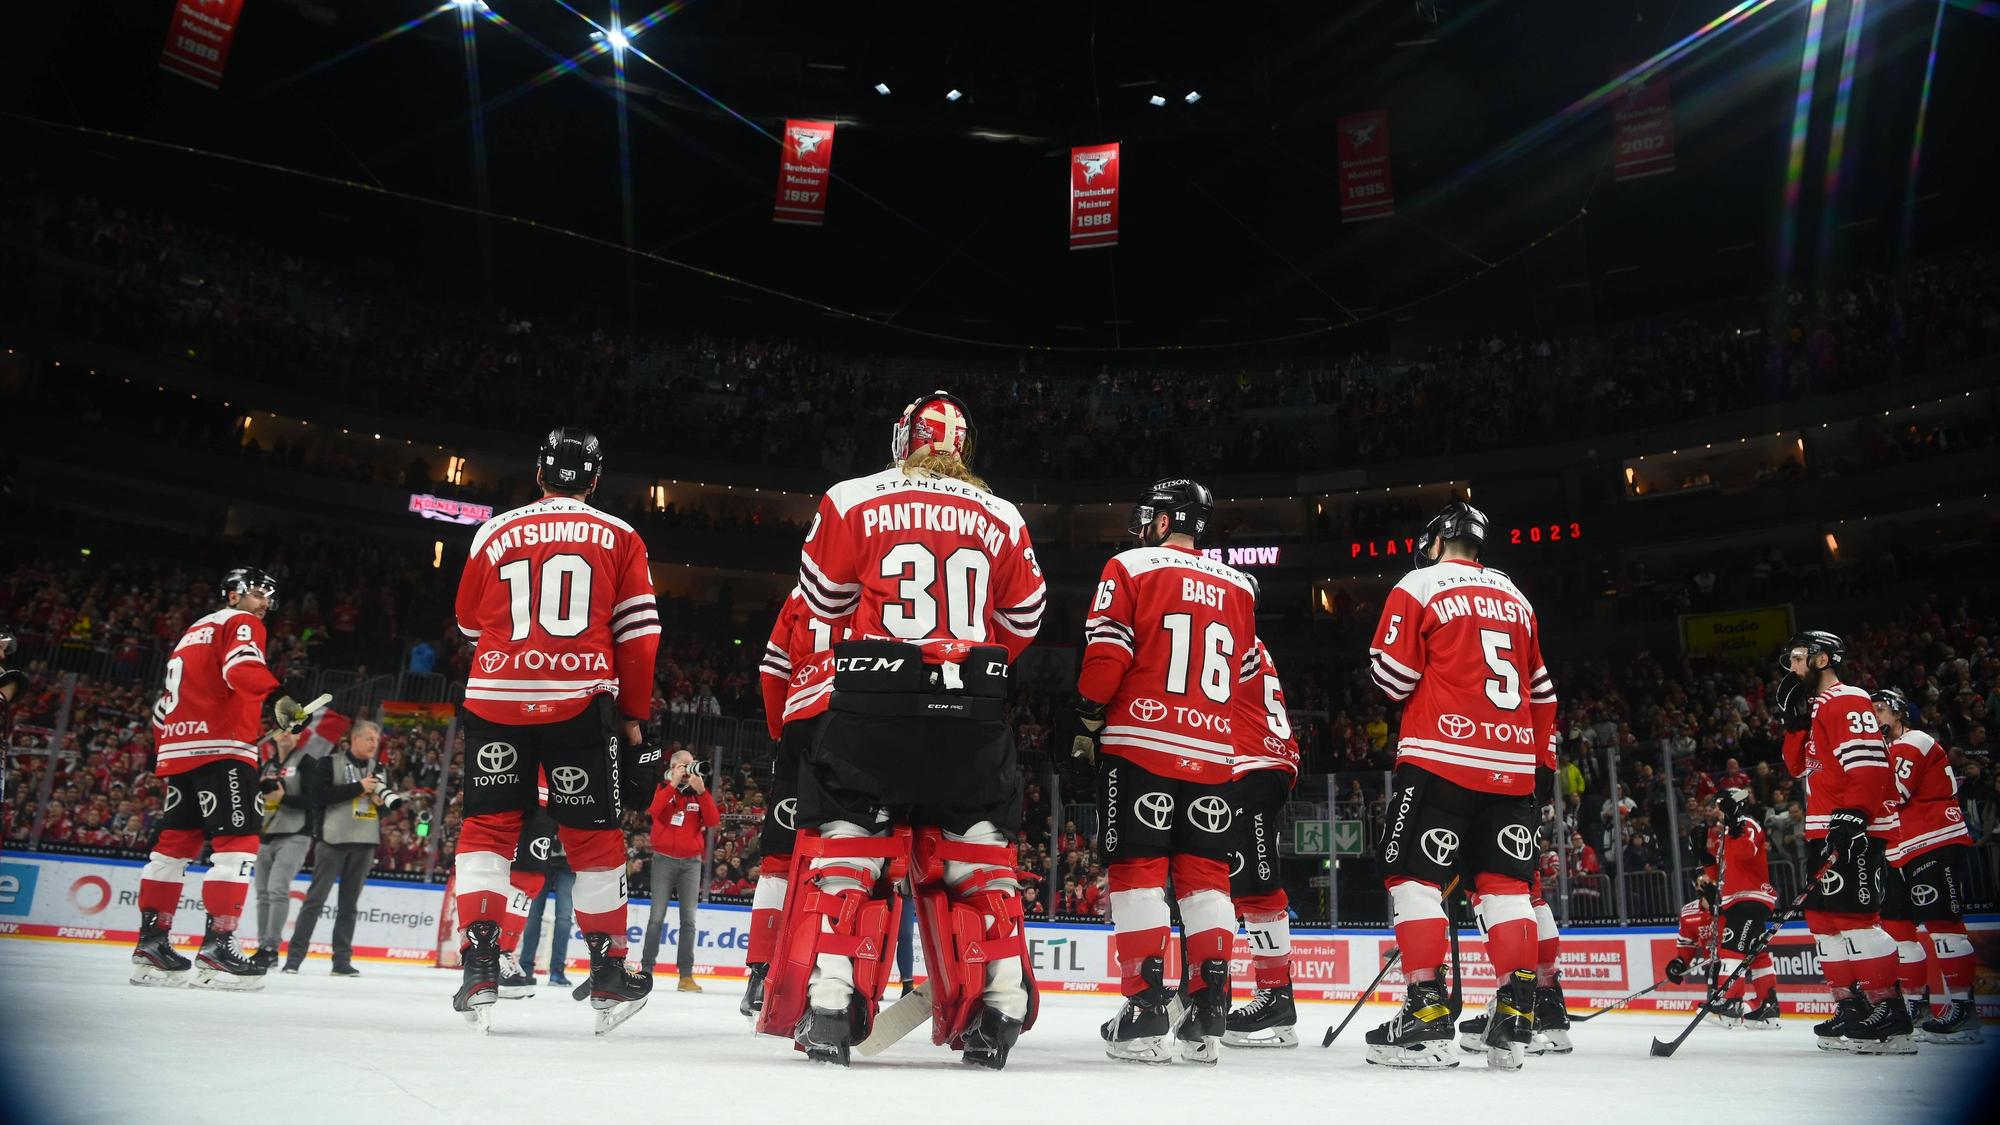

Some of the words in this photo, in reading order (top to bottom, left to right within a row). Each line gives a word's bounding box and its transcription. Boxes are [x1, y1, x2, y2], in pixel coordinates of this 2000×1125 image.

[784, 162, 827, 174] Deutscher
[1342, 155, 1386, 168] Deutscher
[786, 175, 820, 186] Meister
[1347, 169, 1382, 181] Meister
[784, 189, 819, 203] 1987
[1074, 187, 1115, 198] Deutscher
[1078, 201, 1111, 209] Meister
[1077, 213, 1111, 227] 1988
[546, 455, 554, 465] 10
[584, 462, 592, 471] 10
[874, 478, 993, 510] STAHLWERK
[1153, 479, 1190, 491] STETSON
[1175, 512, 1186, 521] 16
[862, 502, 1005, 558] PANTKOWSKI
[1510, 522, 1583, 544] 2023
[485, 521, 615, 567] MATSUMOTO
[1350, 538, 1414, 558] PLAY
[1227, 546, 1279, 565] NOW
[500, 553, 593, 642] 10
[881, 542, 990, 642] 30
[1093, 579, 1116, 613] 16
[1182, 577, 1226, 611] BAST
[1431, 594, 1473, 625] VAN
[236, 624, 252, 641] 9
[1384, 614, 1402, 646] 5
[513, 649, 609, 671] TOYOTA
[833, 657, 905, 673] CCM
[1163, 612, 1235, 705] 16
[1480, 627, 1522, 712] 5
[165, 655, 184, 716] 9
[1846, 710, 1879, 734] 39
[1480, 721, 1536, 745] TOYOT
[228, 768, 243, 810] TOYOTA
[473, 774, 520, 787] TOYOTA
[610, 763, 622, 819] TOYOTA
[1108, 768, 1118, 827] TOYOTA
[1394, 786, 1415, 840] TOYOTA
[1255, 813, 1267, 861] TOYOTA
[1944, 867, 1957, 900] TOYOTA
[1589, 952, 1621, 963] HAIE!
[1062, 982, 1099, 991] PENNY.
[1322, 991, 1359, 1000] PENNY.
[1656, 1000, 1693, 1010] PENNY.
[1795, 1002, 1838, 1013] PENNY
